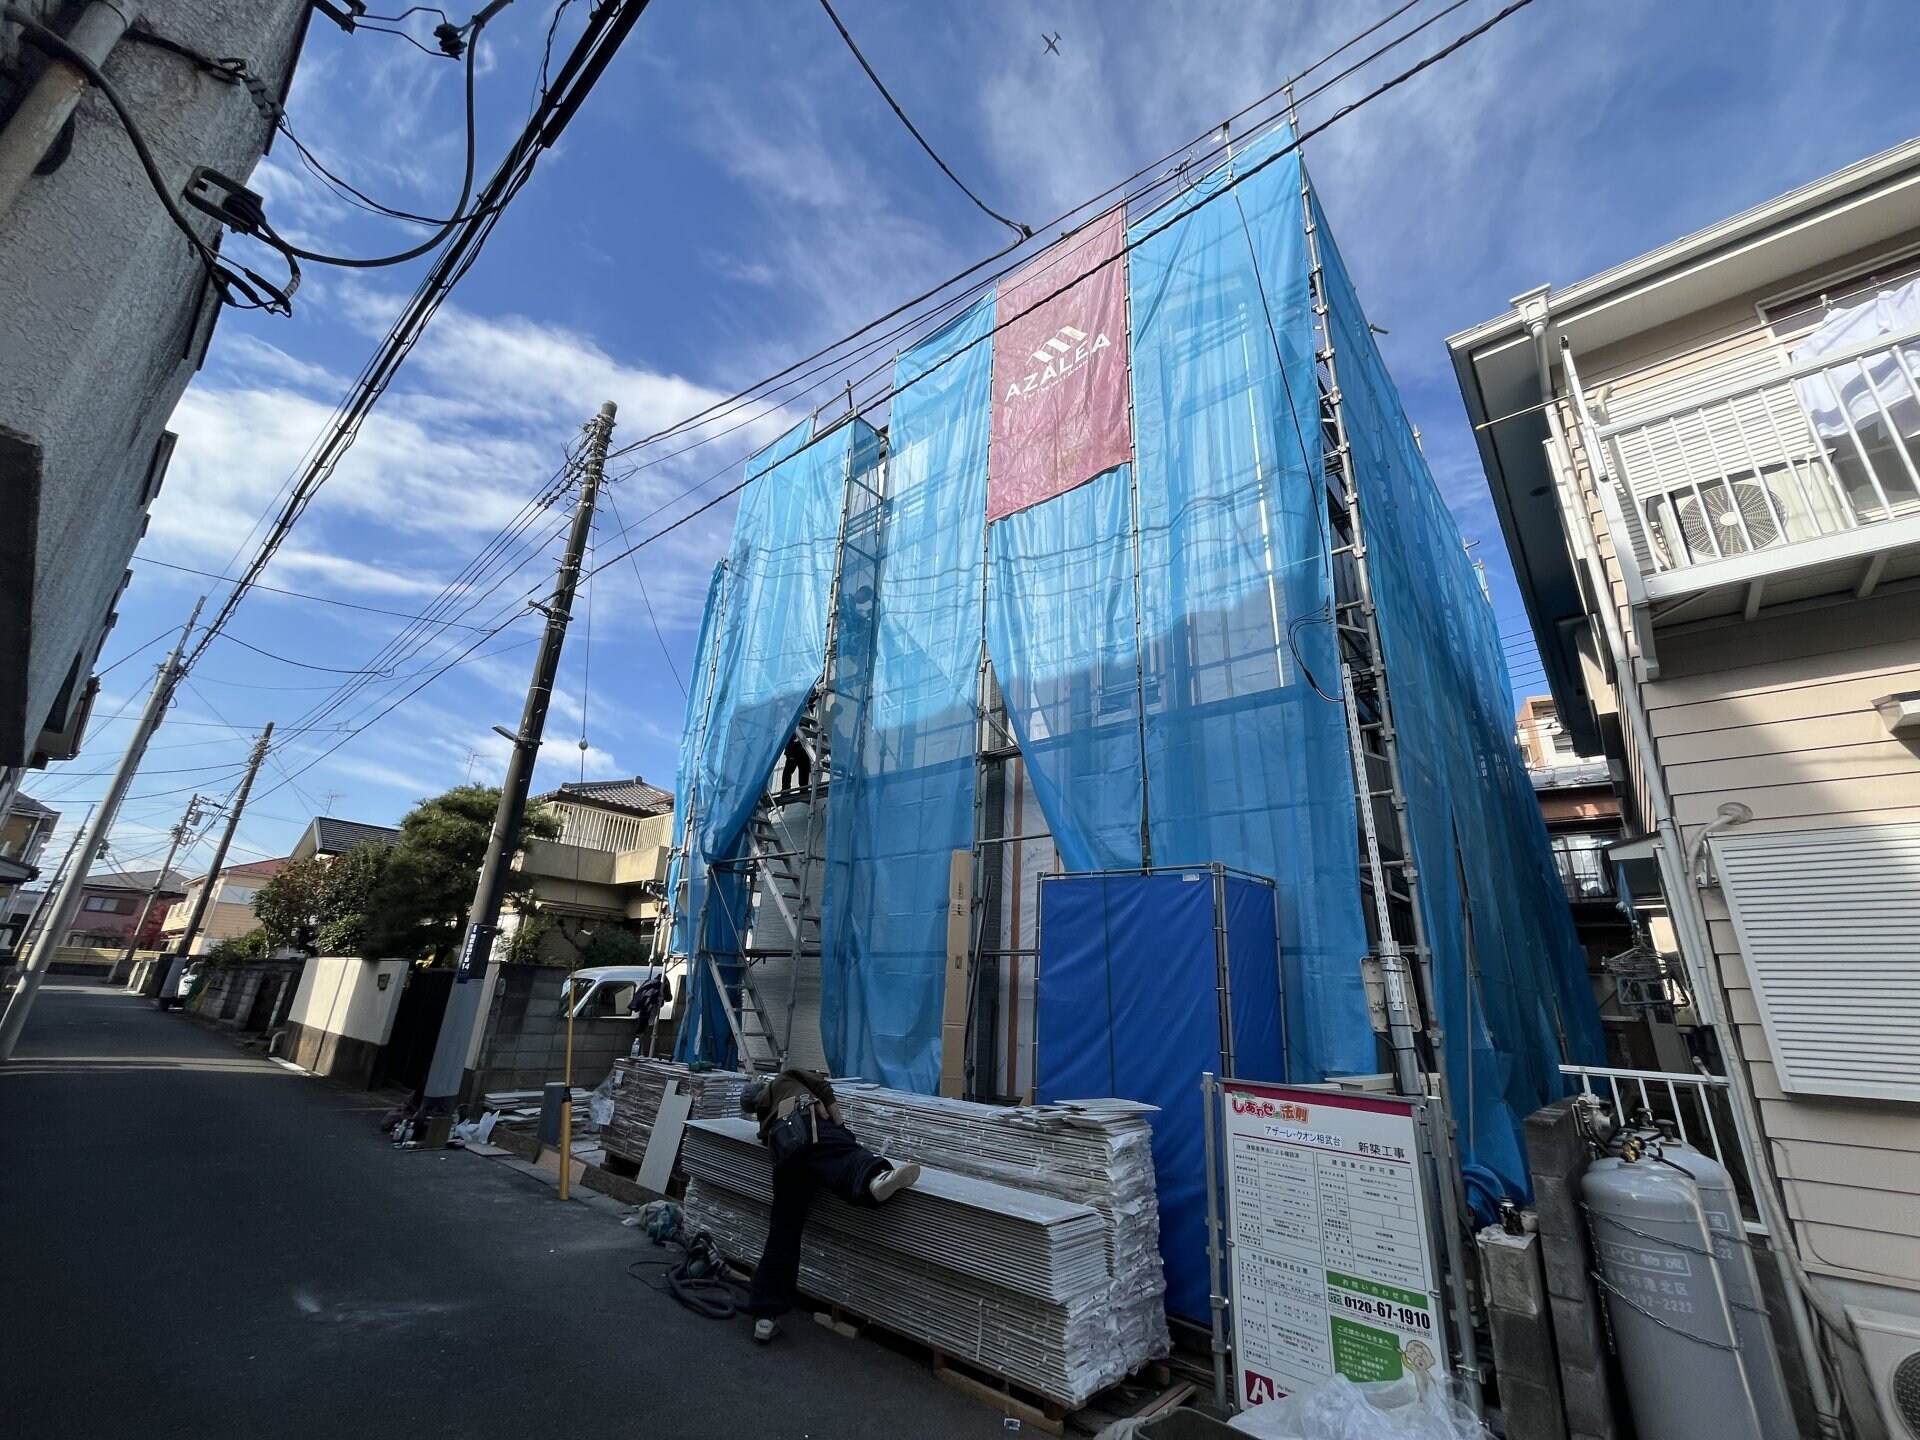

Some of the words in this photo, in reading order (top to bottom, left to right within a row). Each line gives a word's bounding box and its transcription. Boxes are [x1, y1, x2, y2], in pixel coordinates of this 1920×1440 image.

[1004, 333, 1111, 403] AZALEA
[1358, 1141, 1406, 1159] 新築工事
[1344, 1296, 1431, 1330] 0120-67-1910
